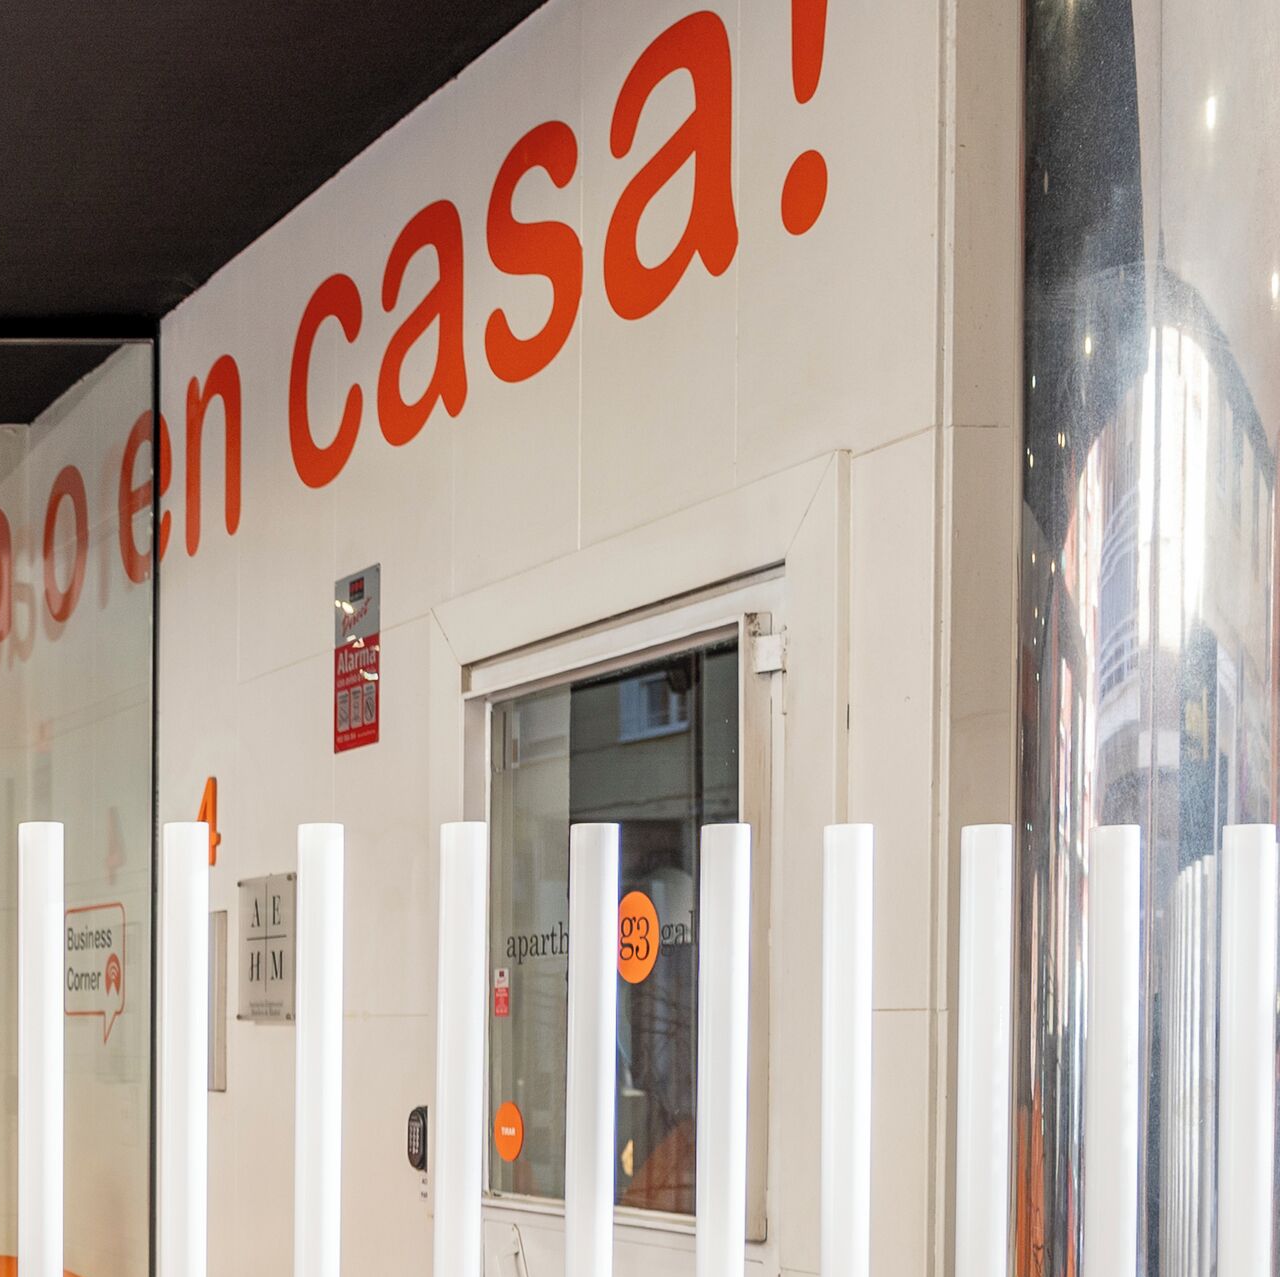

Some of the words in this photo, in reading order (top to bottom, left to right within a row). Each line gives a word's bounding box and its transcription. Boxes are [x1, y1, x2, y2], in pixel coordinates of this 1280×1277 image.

[289, 0, 828, 489] casa!
[337, 643, 377, 677] Alarma
[251, 898, 261, 928] A
[272, 896, 281, 926] E
[66, 926, 113, 951] Business
[506, 921, 569, 965] aparth
[619, 915, 650, 961] g3
[660, 910, 697, 958] gal
[66, 966, 102, 991] Corner
[271, 951, 284, 981] M
